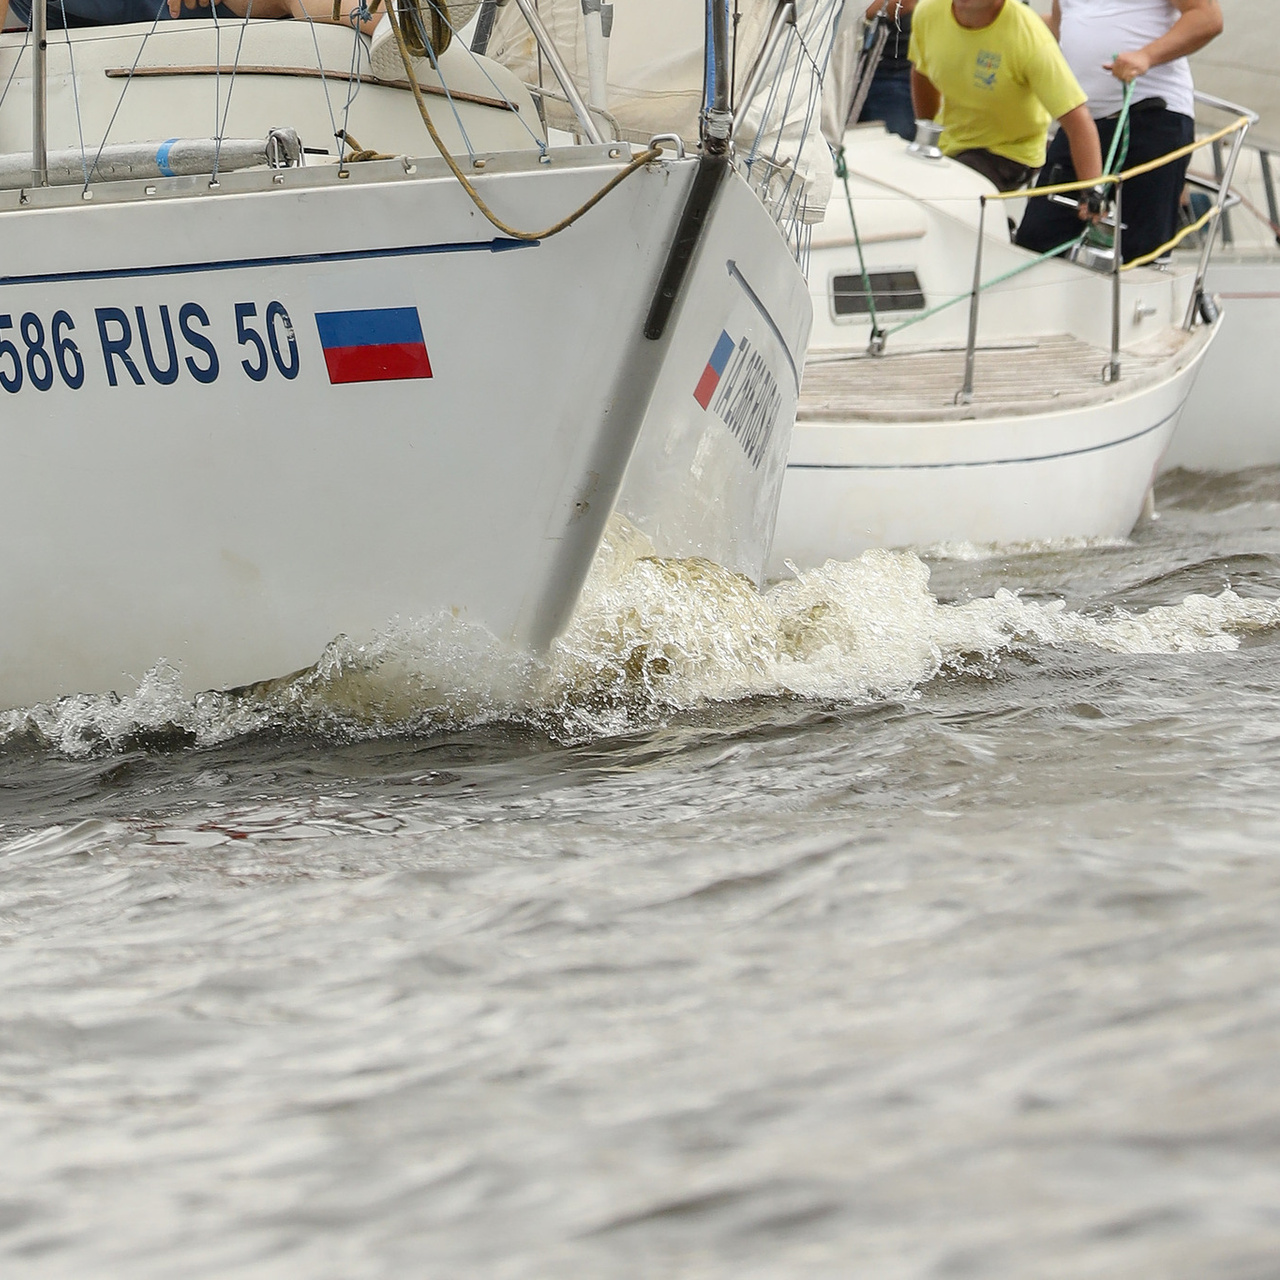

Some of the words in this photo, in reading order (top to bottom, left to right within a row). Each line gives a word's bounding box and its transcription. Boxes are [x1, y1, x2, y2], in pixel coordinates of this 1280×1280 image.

[94, 301, 220, 387] RUS
[235, 301, 300, 382] 50
[714, 336, 751, 418] TA
[739, 369, 777, 459] RUS
